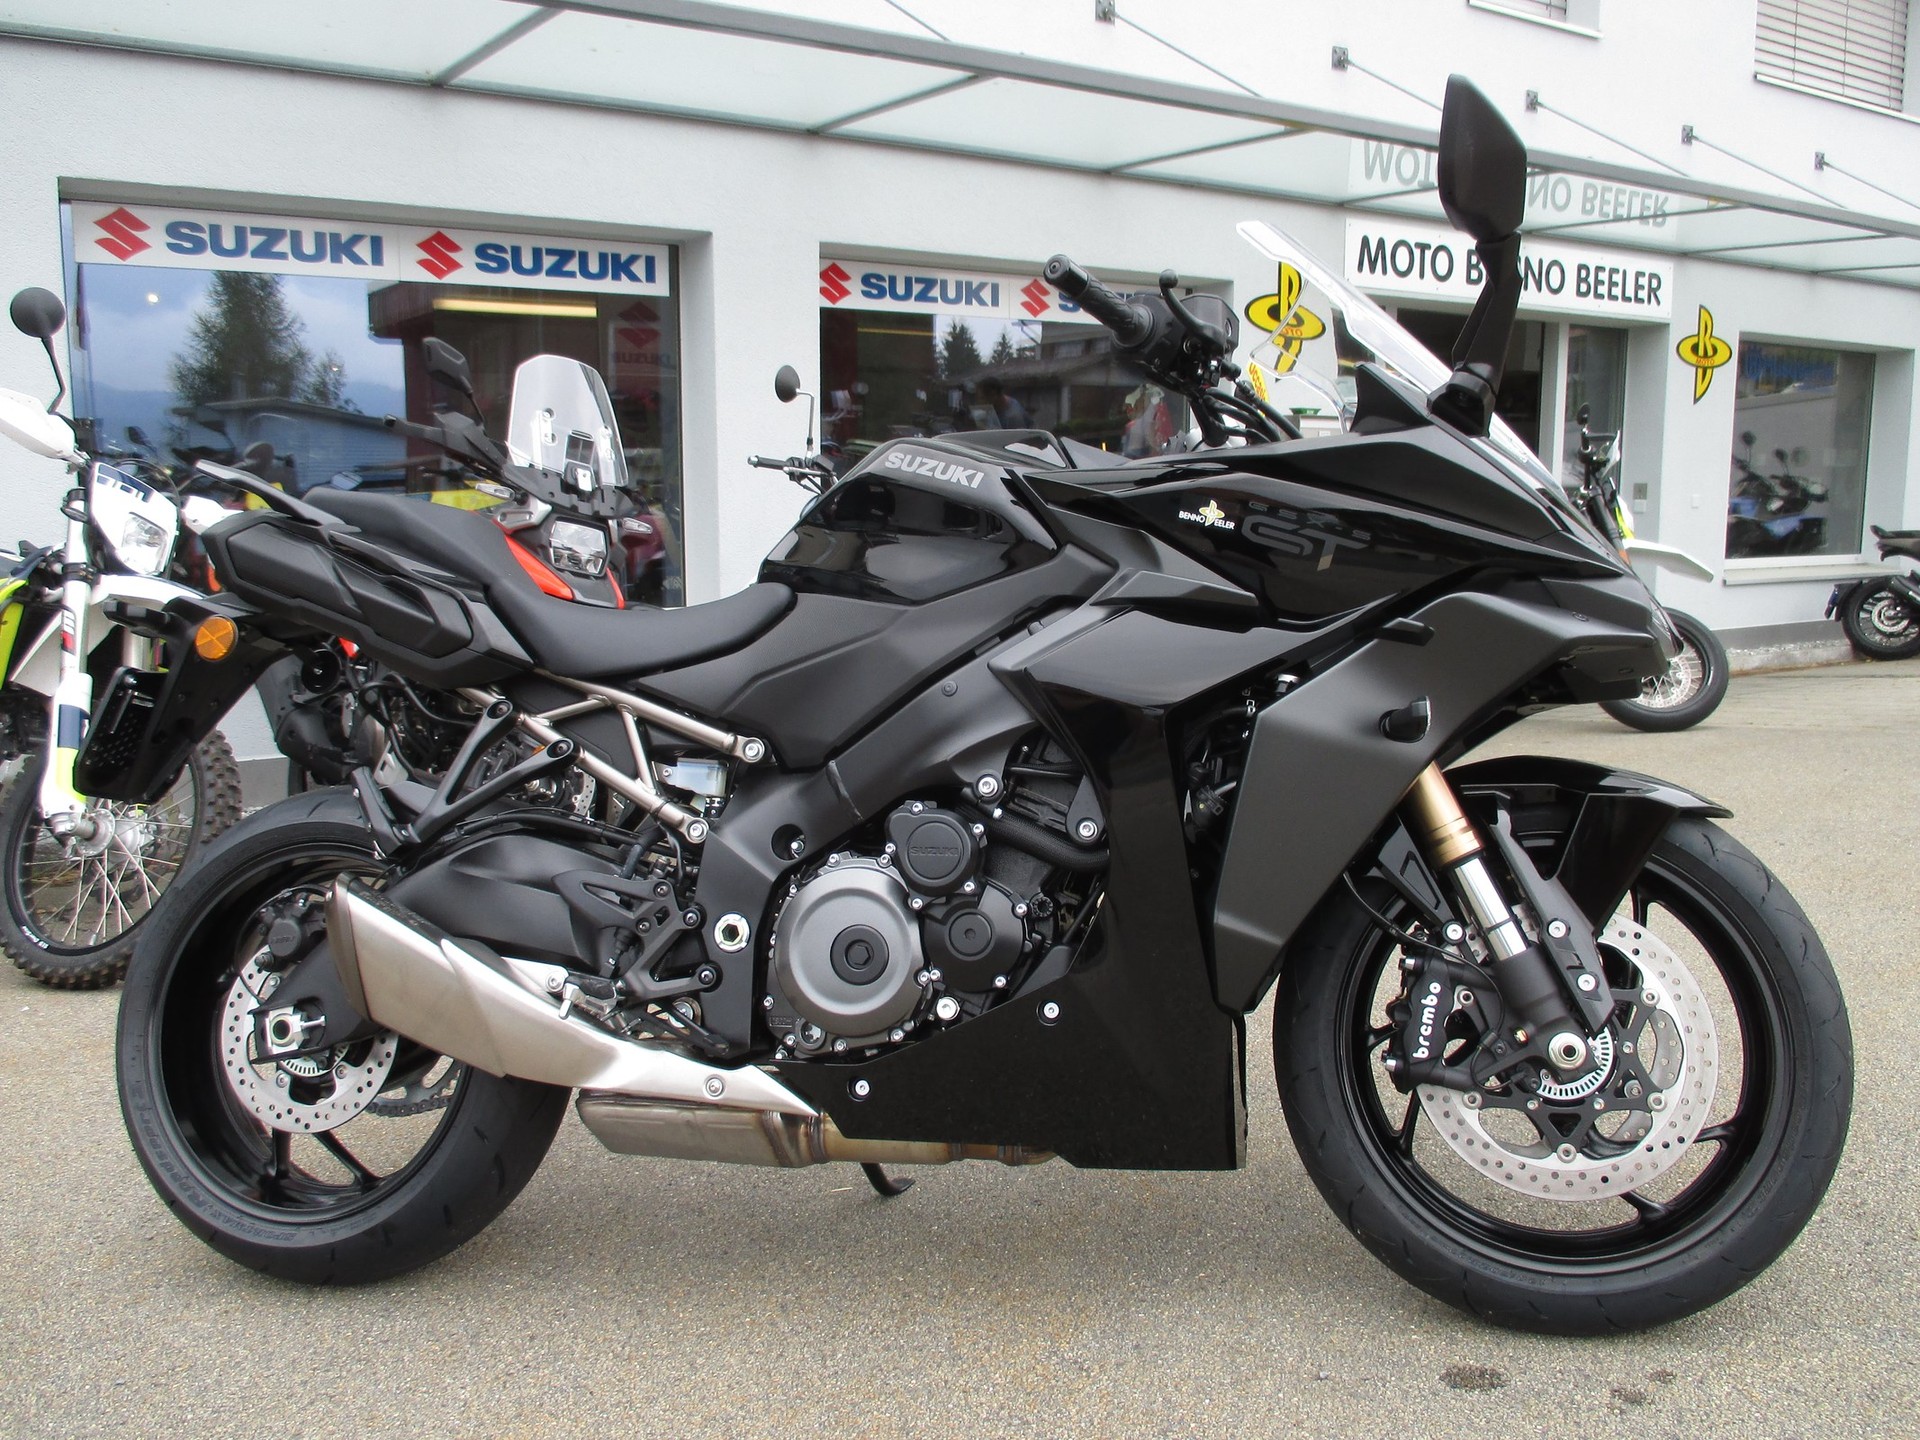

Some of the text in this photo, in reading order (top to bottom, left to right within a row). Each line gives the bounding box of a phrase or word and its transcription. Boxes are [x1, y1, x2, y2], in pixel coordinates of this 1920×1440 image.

[165, 220, 385, 267] SUZUKI
[474, 243, 657, 284] SUZUKI
[1357, 234, 1662, 306] MOTO BNO BEELER
[860, 272, 1000, 307] SUZUKI
[885, 452, 984, 489] SUZUKI
[1179, 510, 1206, 523] BENNO
[910, 846, 960, 857] SUZUKI
[1412, 982, 1442, 1059] brembo
